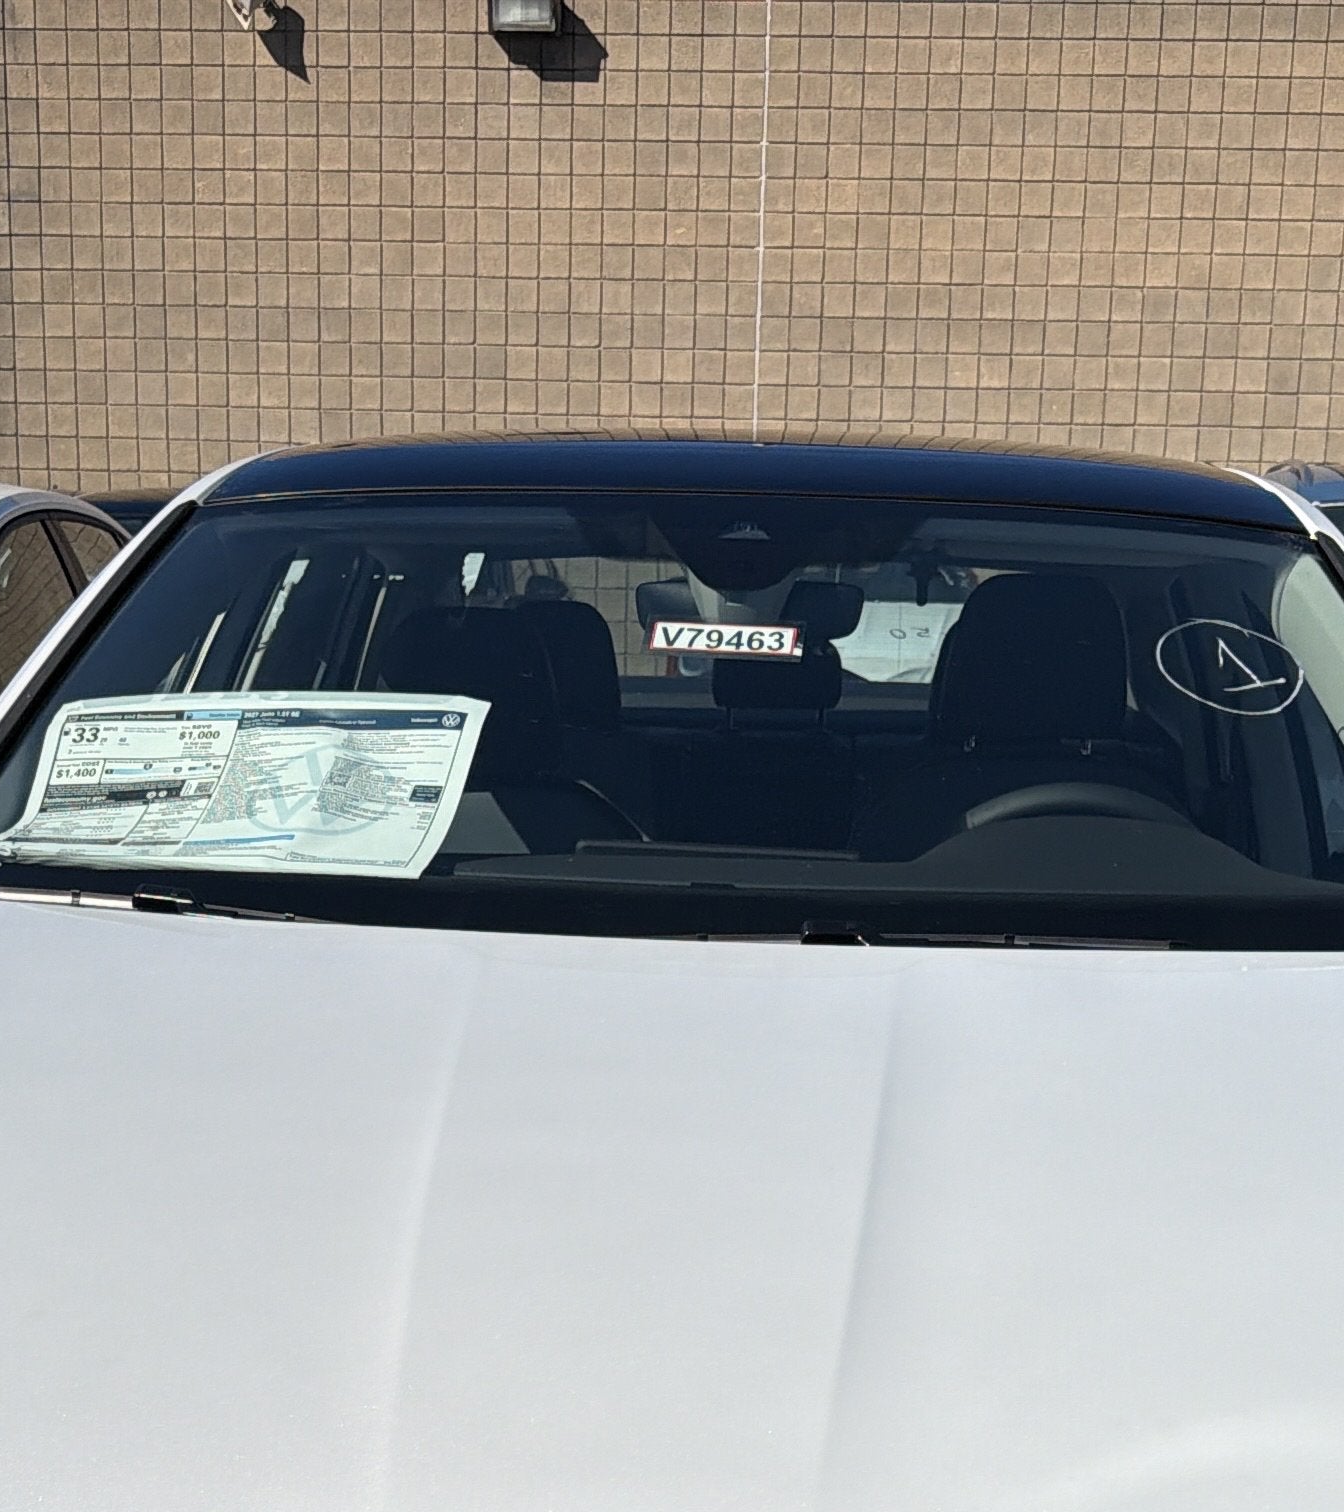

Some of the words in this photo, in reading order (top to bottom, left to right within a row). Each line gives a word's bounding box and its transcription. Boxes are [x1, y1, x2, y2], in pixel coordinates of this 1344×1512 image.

[660, 625, 786, 652] V79463
[71, 726, 100, 743] 33
[178, 730, 221, 741] $1,000
[55, 767, 97, 779] $1,400
